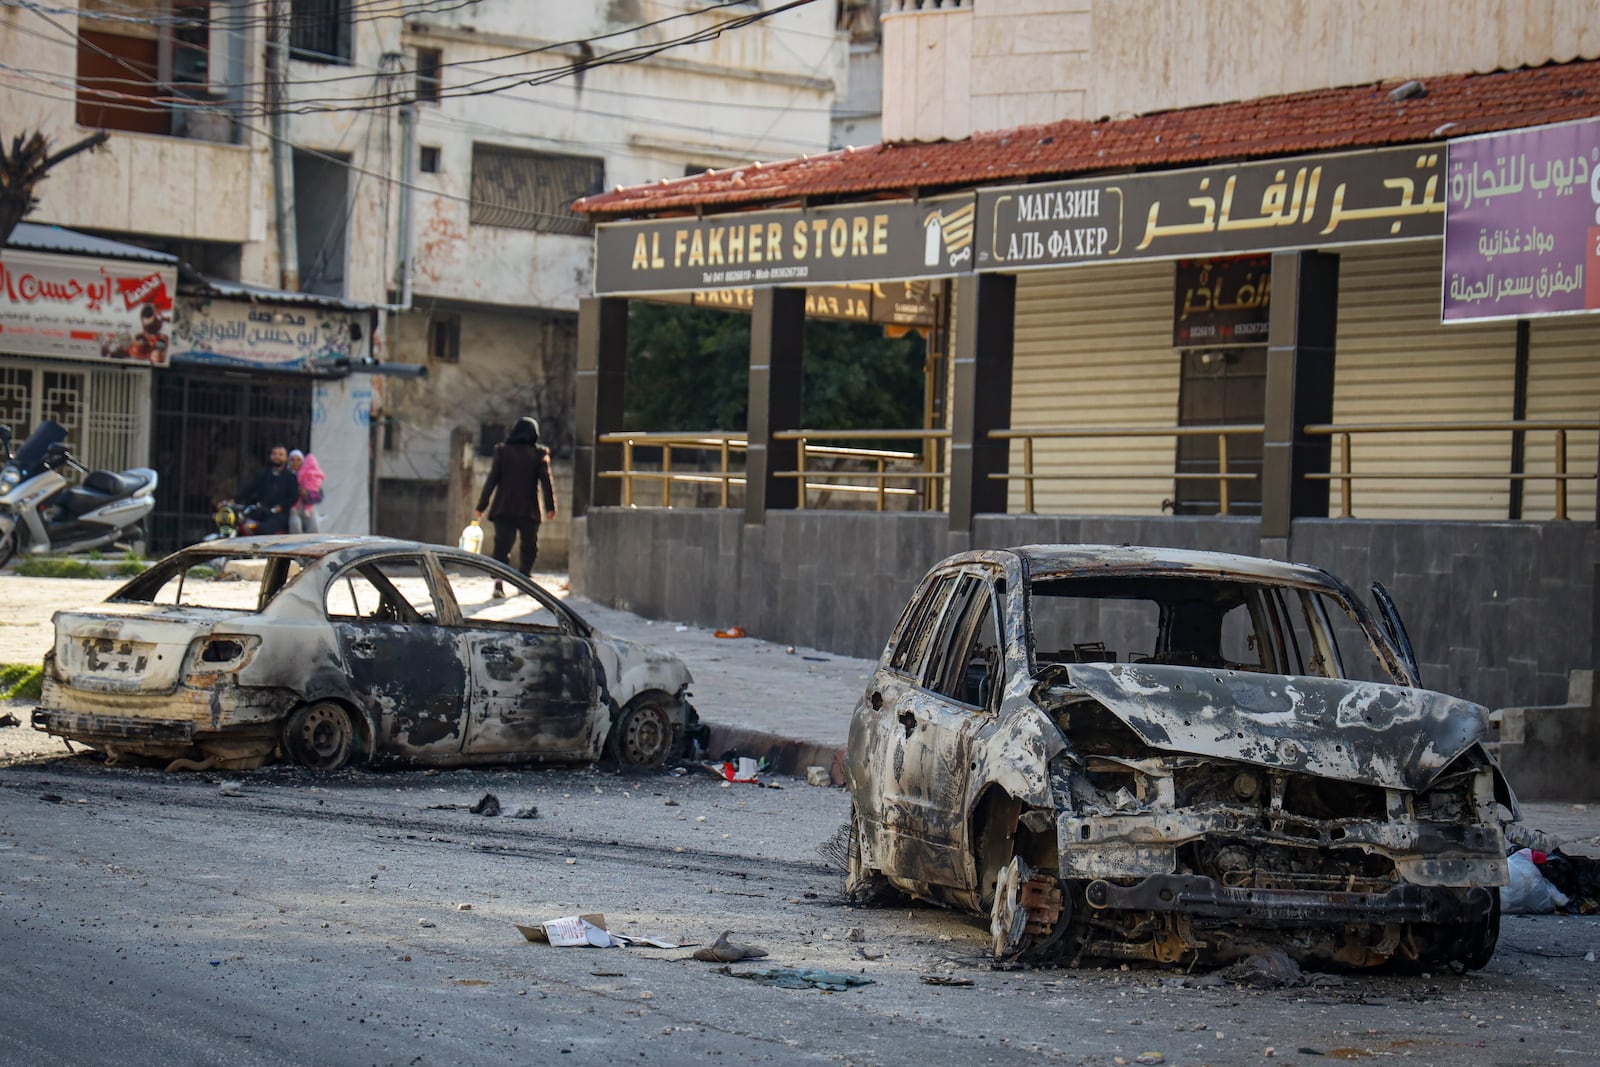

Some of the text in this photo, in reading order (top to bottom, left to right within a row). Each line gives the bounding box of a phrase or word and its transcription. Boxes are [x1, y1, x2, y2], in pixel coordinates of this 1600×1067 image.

[1452, 154, 1525, 209] للتجارة
[1530, 155, 1589, 198] ديوب
[1017, 189, 1100, 222] МАГАЗИН
[1136, 154, 1446, 250] تجر الفاخر
[632, 215, 888, 270] AL FAKHER STORE
[1007, 227, 1108, 261] АЛЬ ФАХЕР
[1479, 226, 1554, 261] مواد غذائية
[19, 274, 83, 301] حسن
[86, 266, 112, 311] أبو
[1180, 272, 1271, 321] الفاخر
[1450, 262, 1583, 304] المفرق بسعر الجملة
